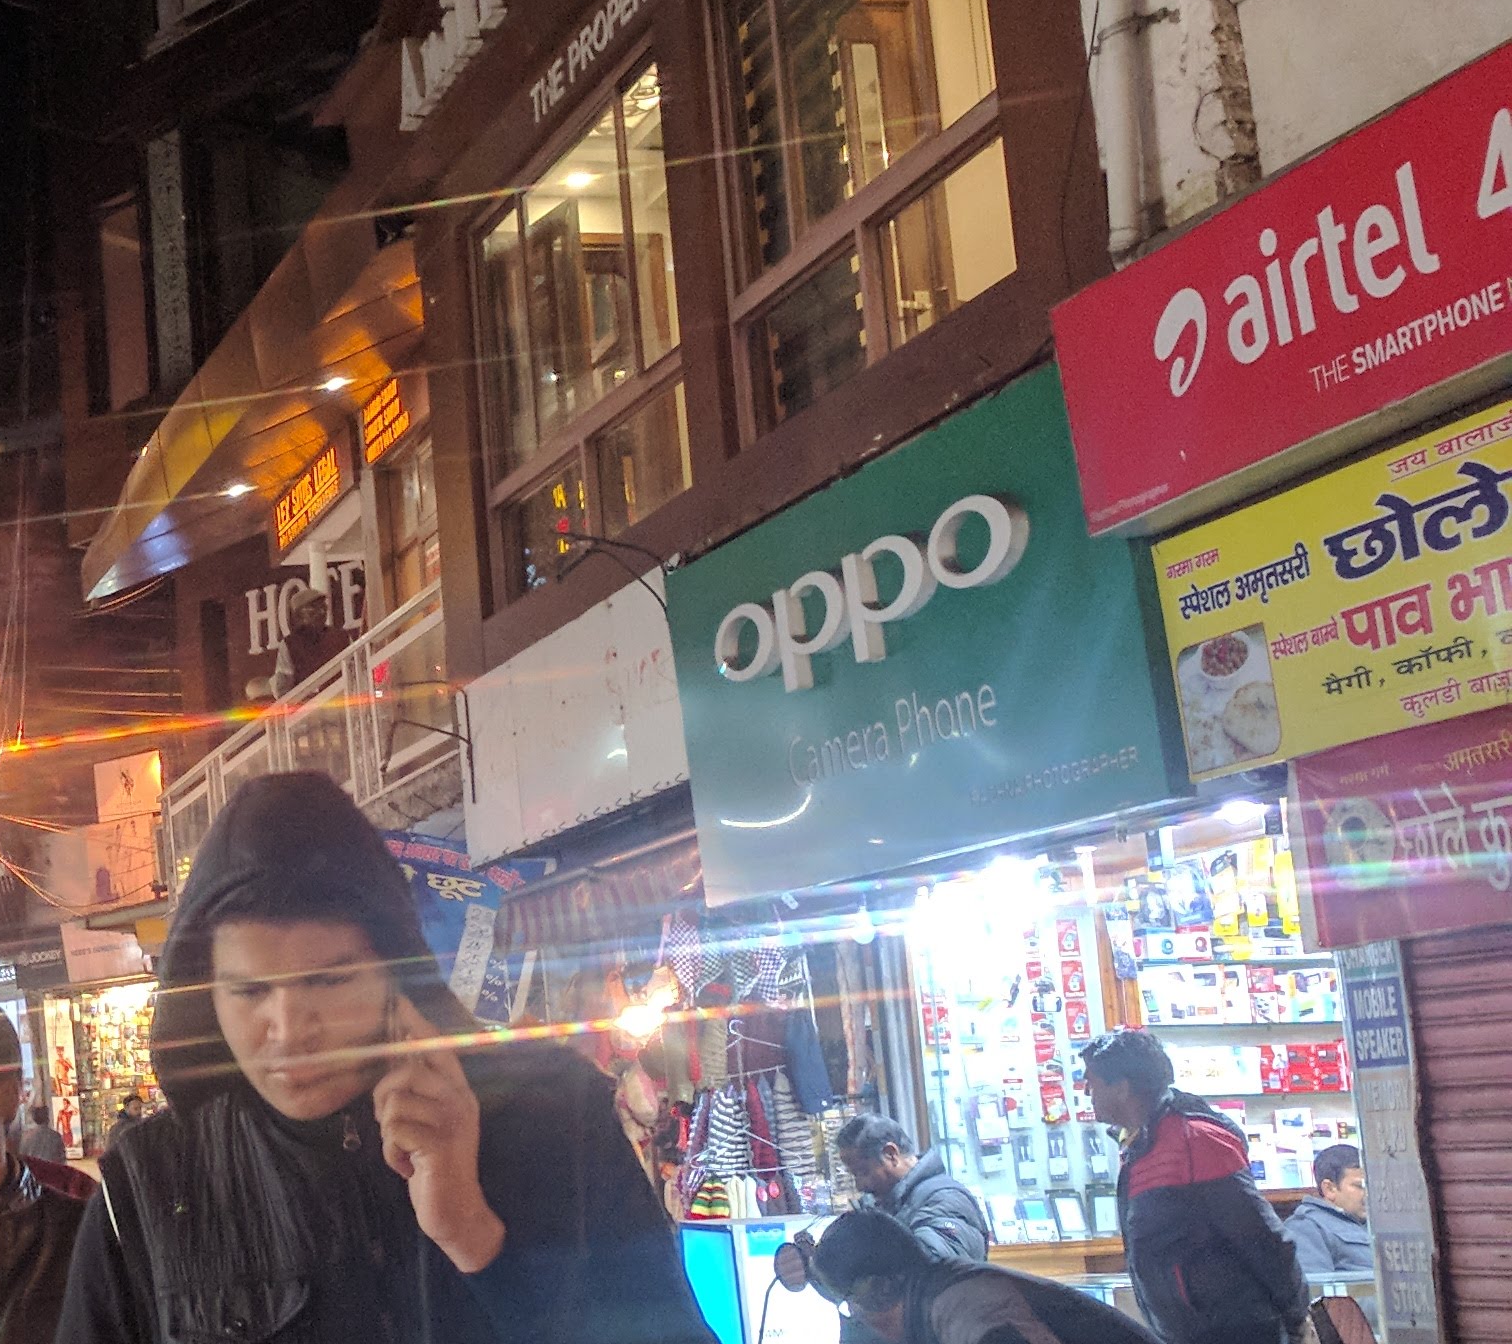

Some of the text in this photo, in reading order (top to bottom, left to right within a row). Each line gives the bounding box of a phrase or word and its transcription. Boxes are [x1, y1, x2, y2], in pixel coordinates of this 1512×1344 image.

[529, 72, 565, 123] THE
[1224, 161, 1441, 364] airtel
[1309, 281, 1505, 392] THE SMARTPHONE
[1388, 449, 1427, 475] जय
[1324, 462, 1509, 580] छोले
[715, 494, 1030, 693] oppo
[1179, 542, 1310, 620] स्पेशल अमृतसरी
[1341, 583, 1433, 651] पाव
[788, 684, 997, 786] Camera Phone
[1025, 746, 1138, 791] PHOTOGRAPHER
[32, 949, 61, 963] JOCKEY
[1353, 986, 1398, 1020] MOBILE
[1355, 1026, 1406, 1061] SPEAKER
[1384, 1240, 1429, 1273] SELFIE
